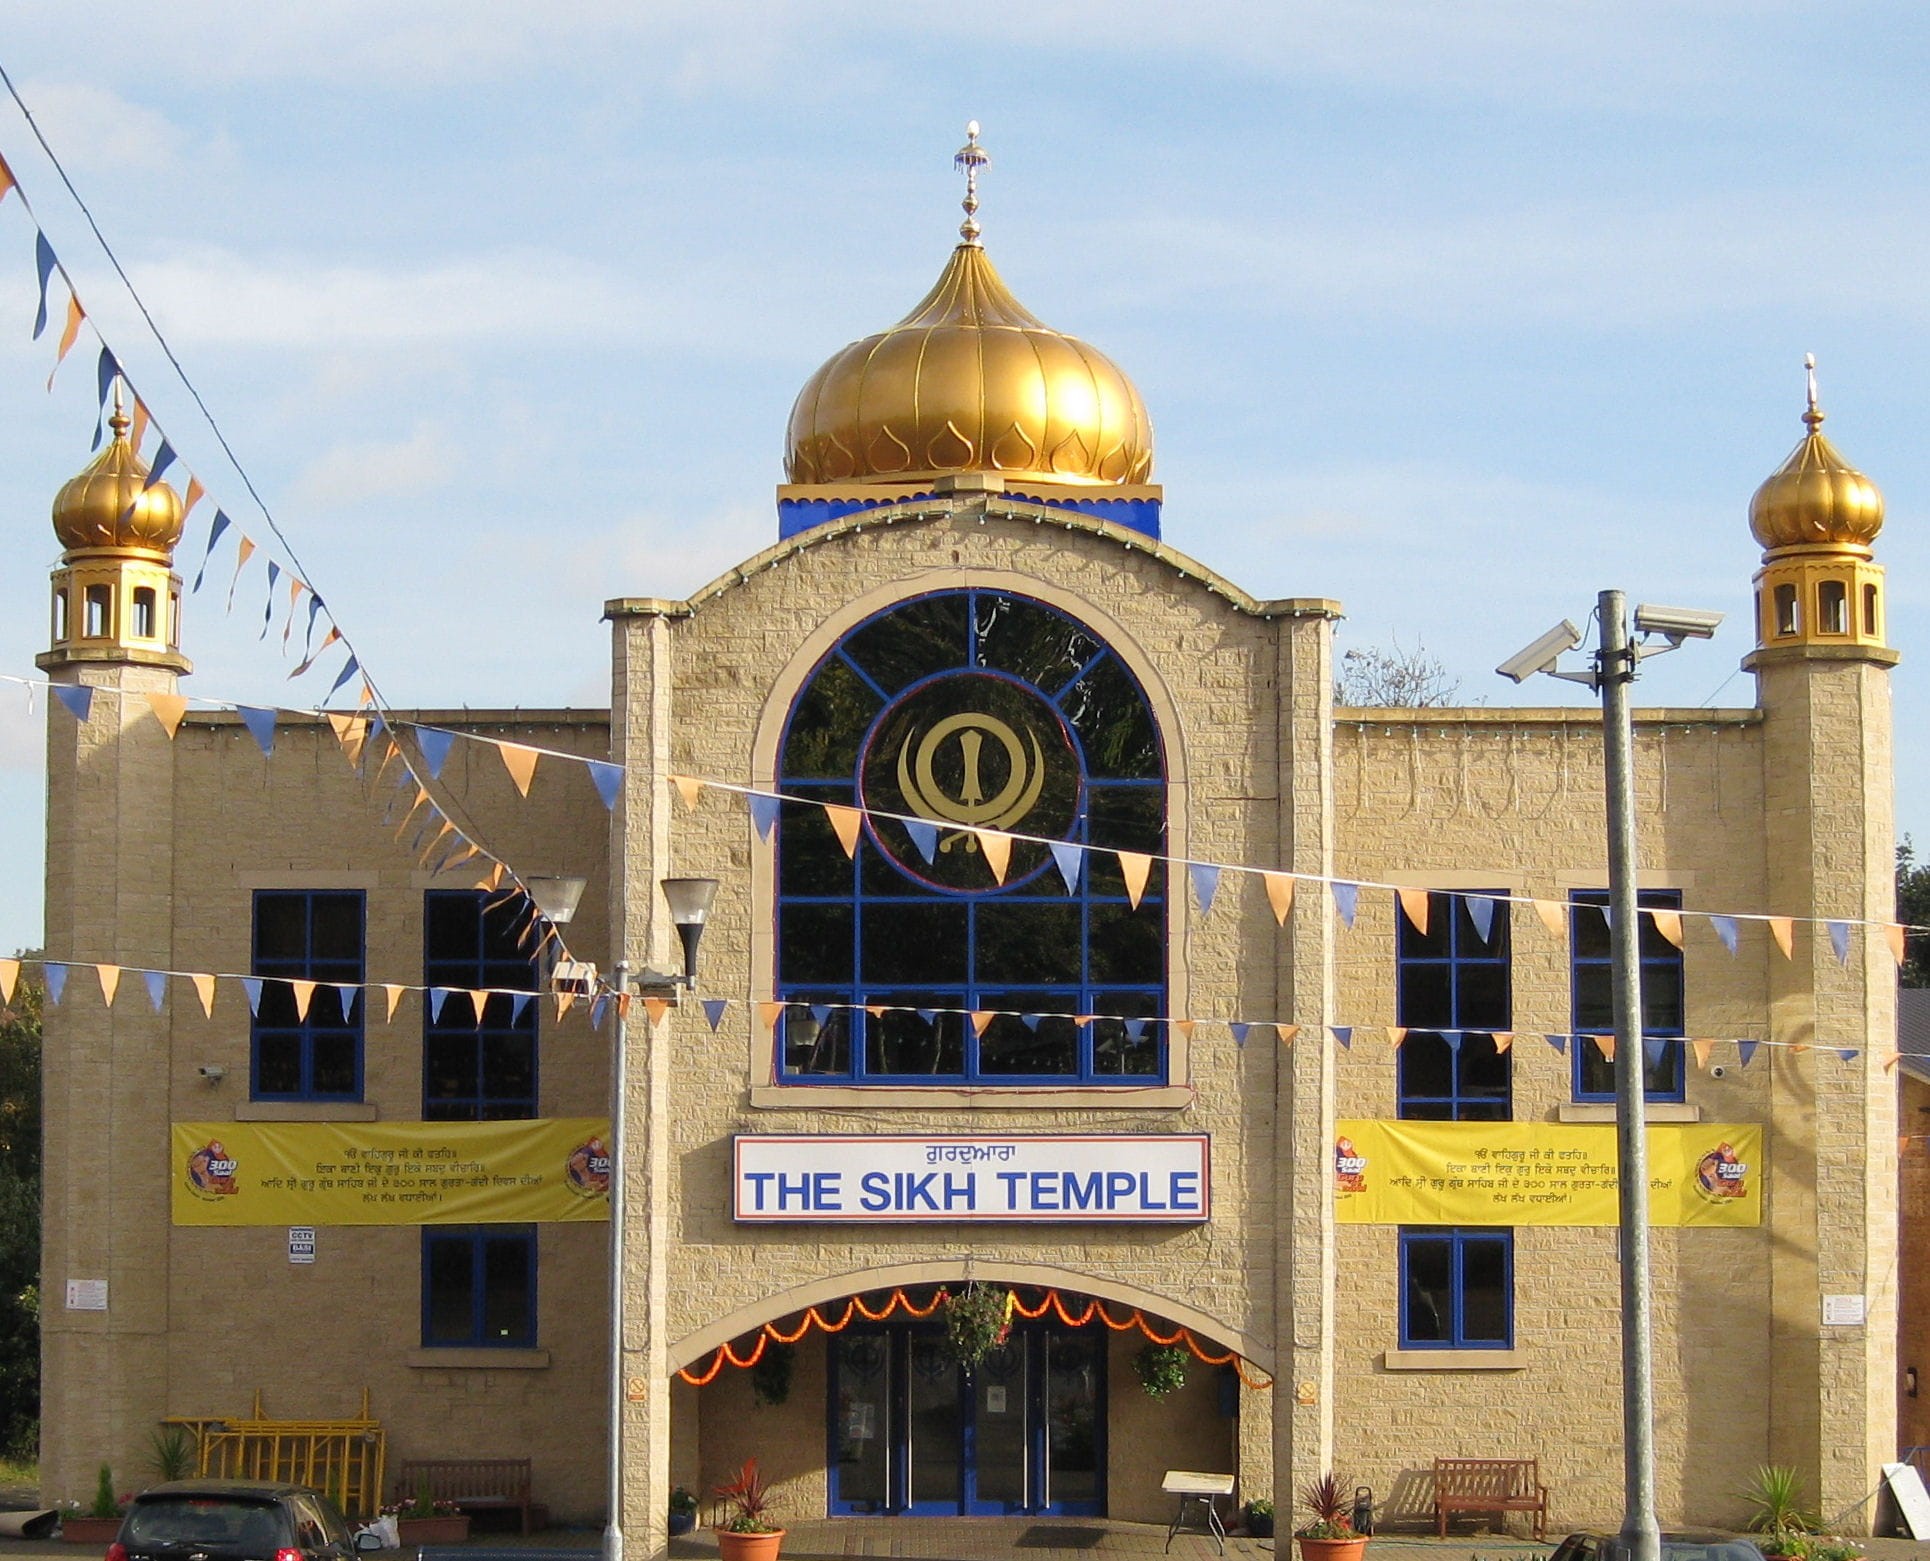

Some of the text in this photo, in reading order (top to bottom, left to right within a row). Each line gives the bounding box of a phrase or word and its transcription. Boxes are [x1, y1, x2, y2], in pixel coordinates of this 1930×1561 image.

[925, 1145, 1016, 1164] ਗੁਰਦੁਆਰਾ
[209, 1160, 238, 1170] 300
[589, 1157, 609, 1167] 30
[1337, 1157, 1367, 1167] 300
[1718, 1163, 1747, 1173] 300
[744, 1172, 1198, 1211] THE SIKH TEMPLE
